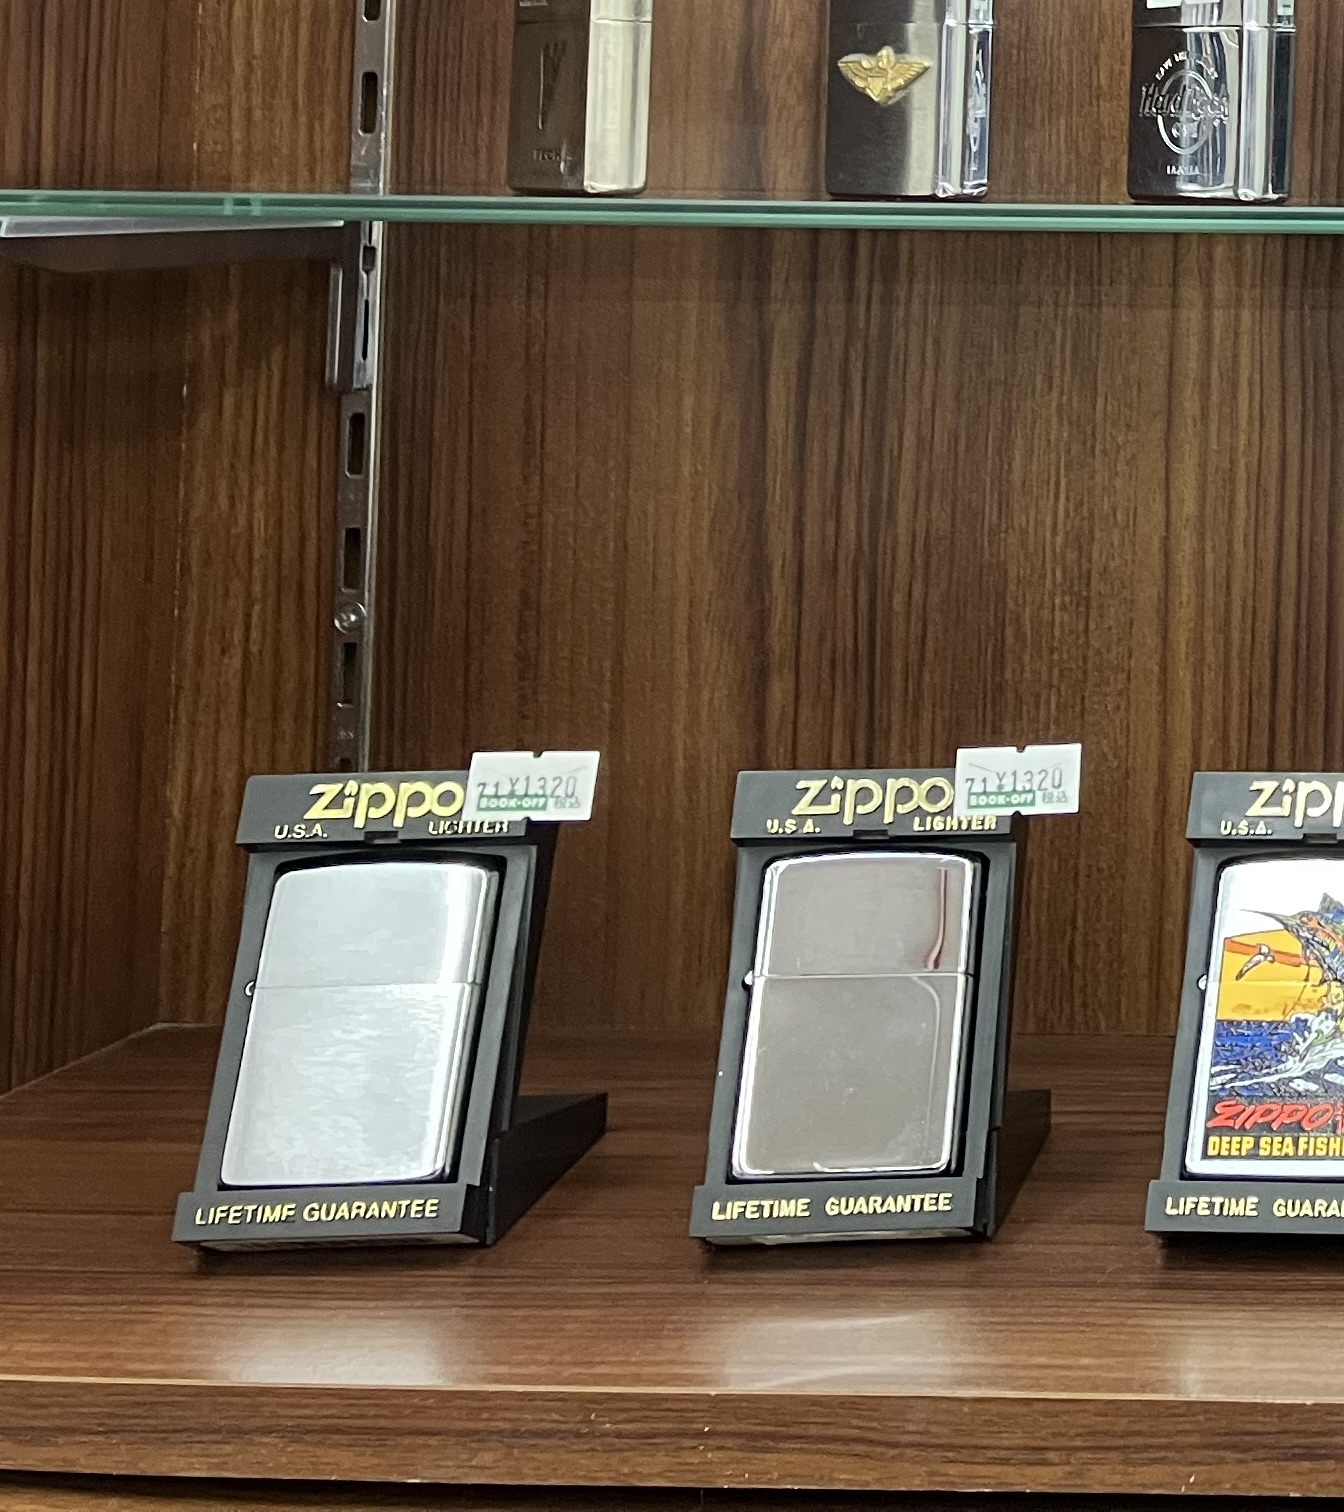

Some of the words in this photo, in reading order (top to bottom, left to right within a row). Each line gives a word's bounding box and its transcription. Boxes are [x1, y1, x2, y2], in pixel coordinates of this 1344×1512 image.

[477, 782, 500, 798] 71
[509, 775, 577, 799] ¥1320
[965, 777, 987, 793] 71
[996, 767, 1062, 791] ¥1320
[274, 824, 328, 840] U.S.A.
[767, 819, 820, 834] U.S.A.
[913, 815, 998, 831] LIGHTER
[1220, 819, 1273, 835] U.S.A.
[1206, 1136, 1254, 1157] DEEP
[1258, 1136, 1294, 1157] SEA
[303, 1198, 440, 1222] GUARANTEE
[711, 1198, 811, 1221] LIFETIME
[824, 1193, 953, 1216] GUARANTEE
[1165, 1196, 1260, 1217] LIFETIME
